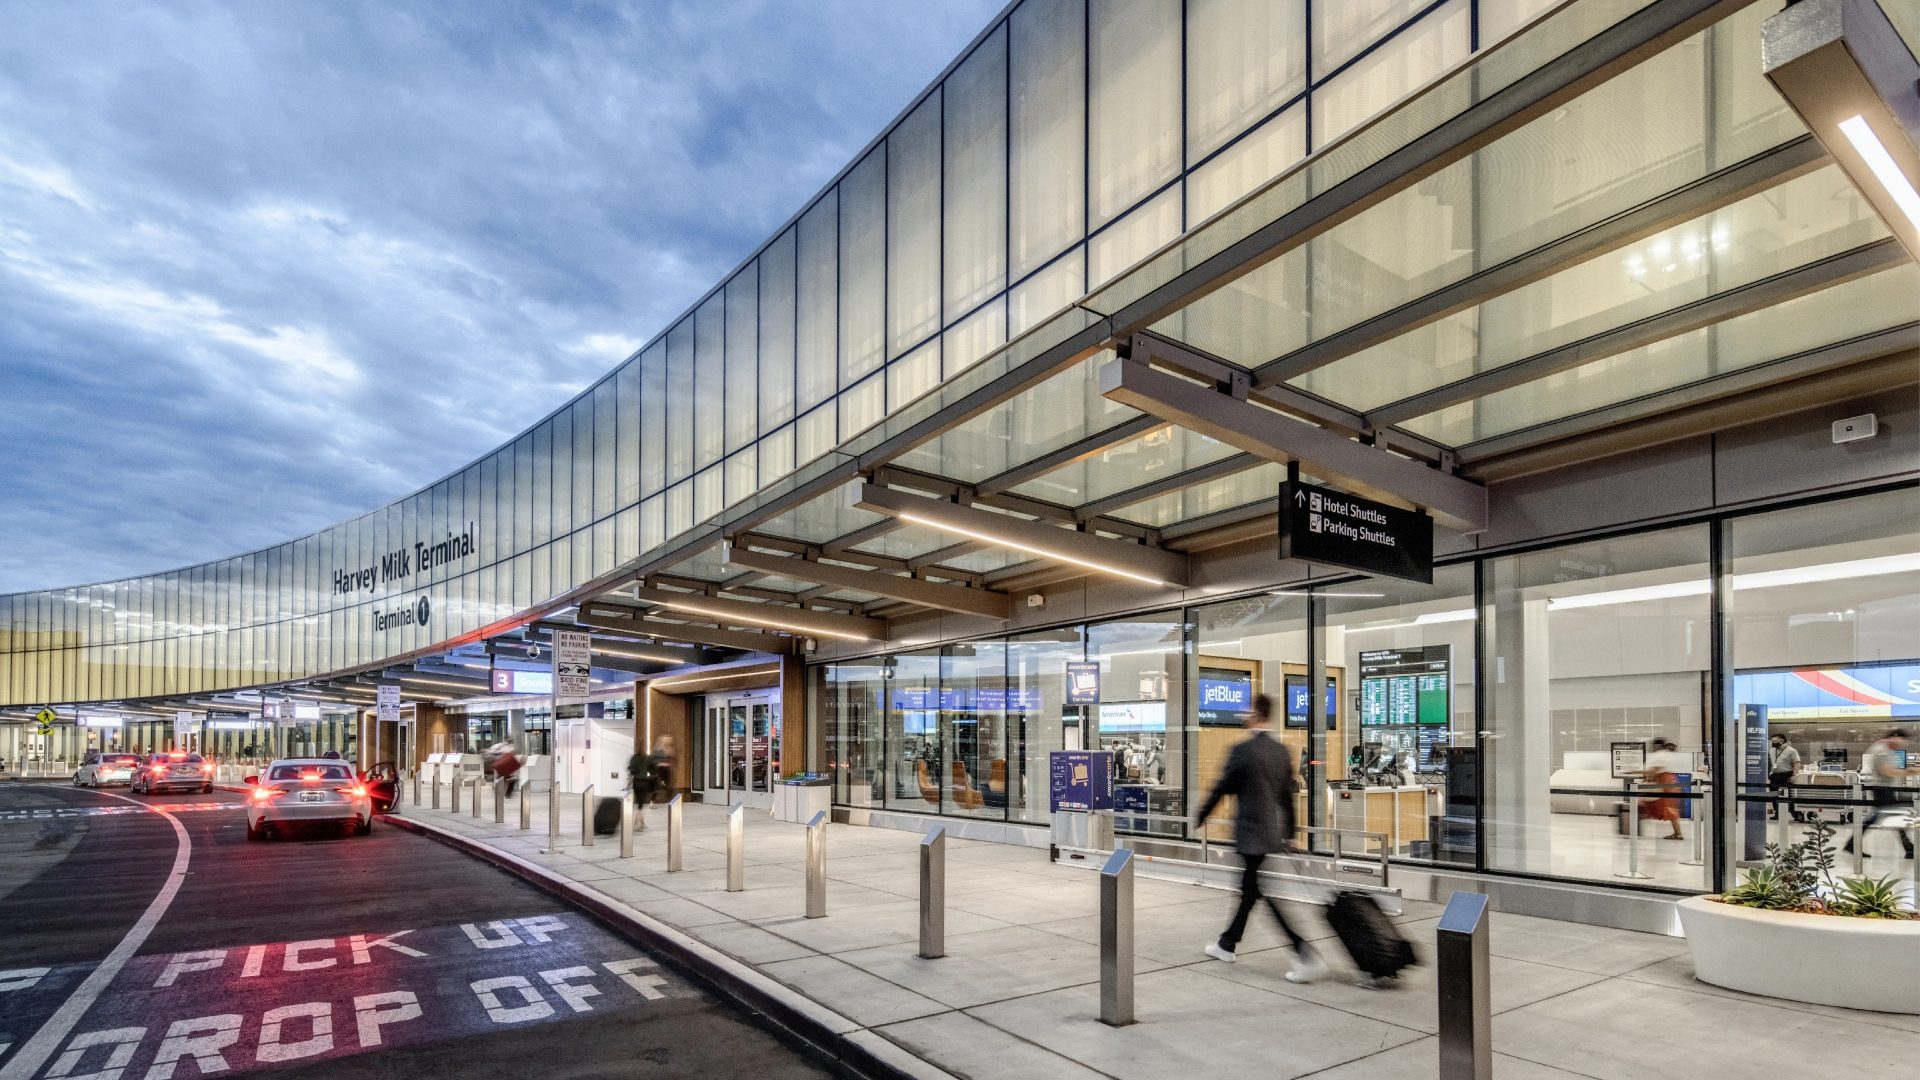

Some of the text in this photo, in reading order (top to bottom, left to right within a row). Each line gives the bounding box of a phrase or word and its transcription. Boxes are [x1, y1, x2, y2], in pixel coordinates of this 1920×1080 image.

[1324, 497, 1387, 525] Hotel Shuttles
[1324, 518, 1395, 547] Parking Shuttles
[333, 521, 475, 596] Harvey Milk Terminal
[374, 602, 415, 632] Terminal
[496, 673, 509, 688] 3
[1204, 684, 1242, 704] jetBlue
[265, 706, 274, 715] 4
[153, 916, 570, 987] PICK UP
[40, 957, 668, 1080] DROP OFF
